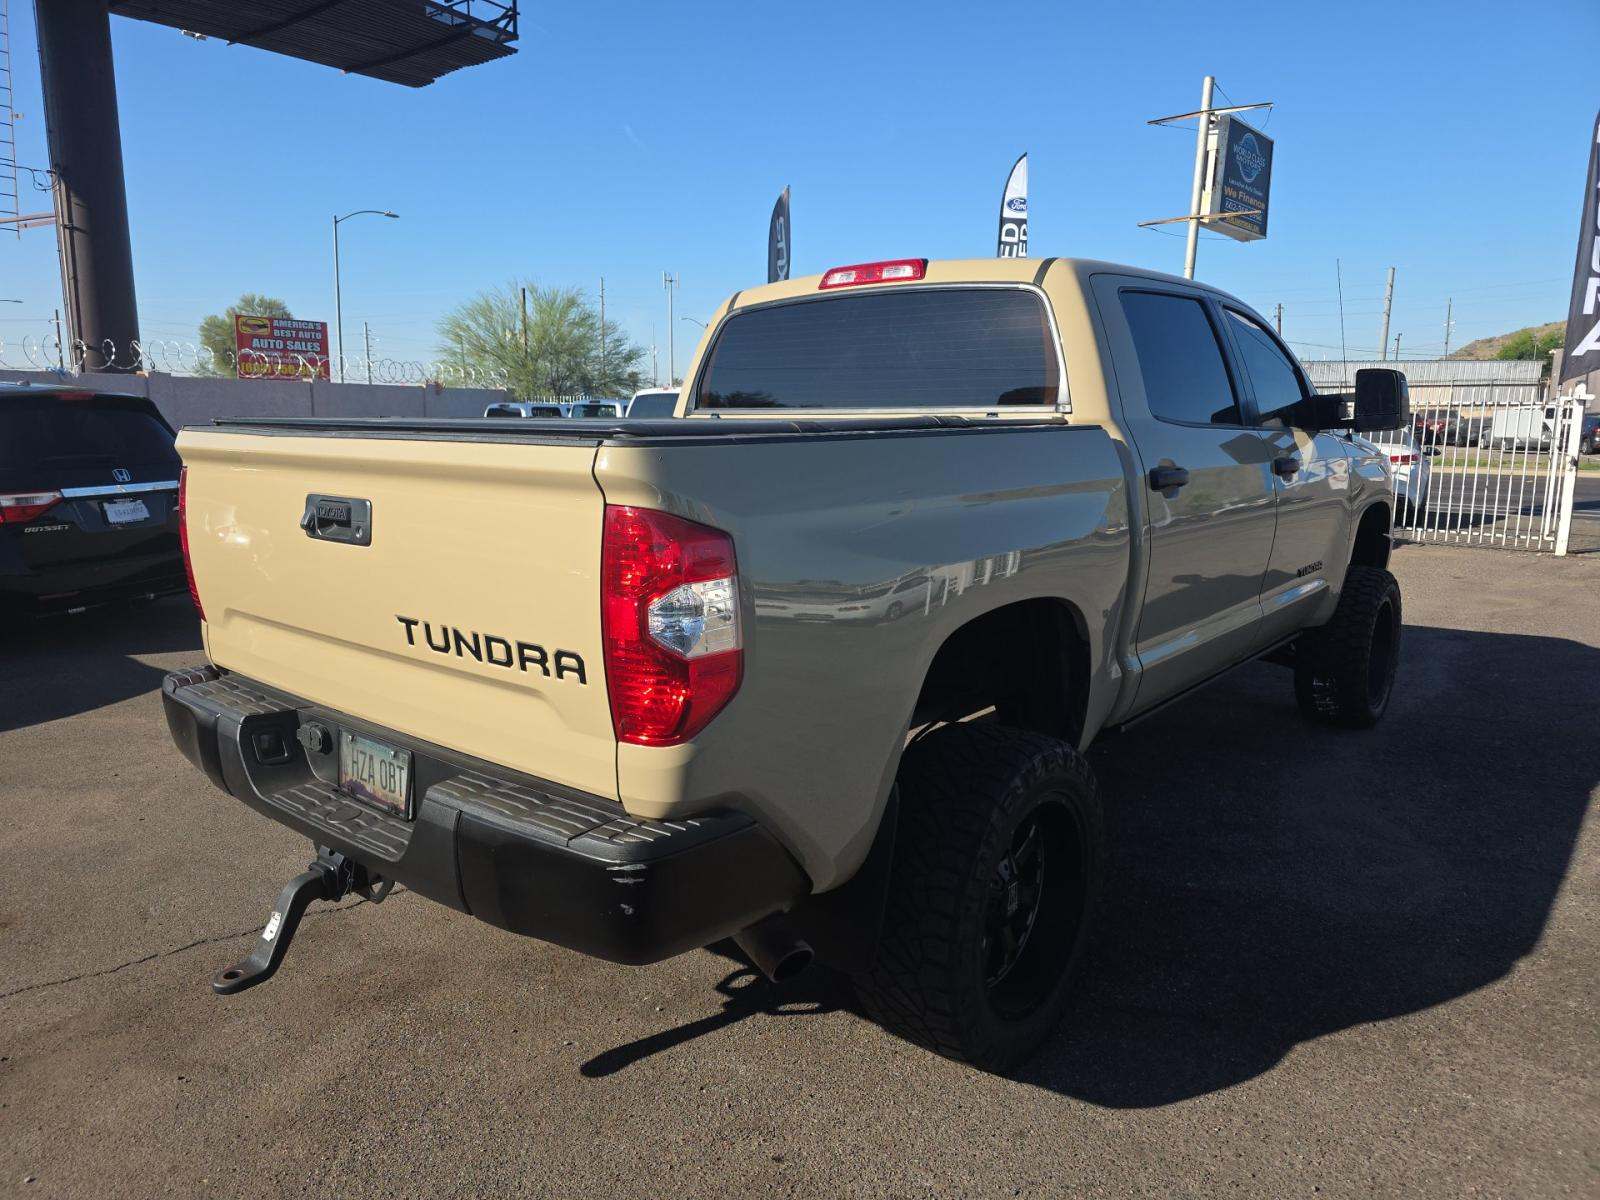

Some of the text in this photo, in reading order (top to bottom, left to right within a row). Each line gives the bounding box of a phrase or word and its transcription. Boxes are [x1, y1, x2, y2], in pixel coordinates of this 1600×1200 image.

[1233, 143, 1266, 168] WORLD CLASS
[1223, 185, 1237, 198] We
[1237, 191, 1266, 210] Finance
[272, 319, 322, 330] AMERICA'S
[273, 329, 322, 339] BEST AUTO
[252, 338, 321, 352] AUTO SALES
[395, 614, 587, 685] TUNDRA
[351, 748, 376, 786] HZA
